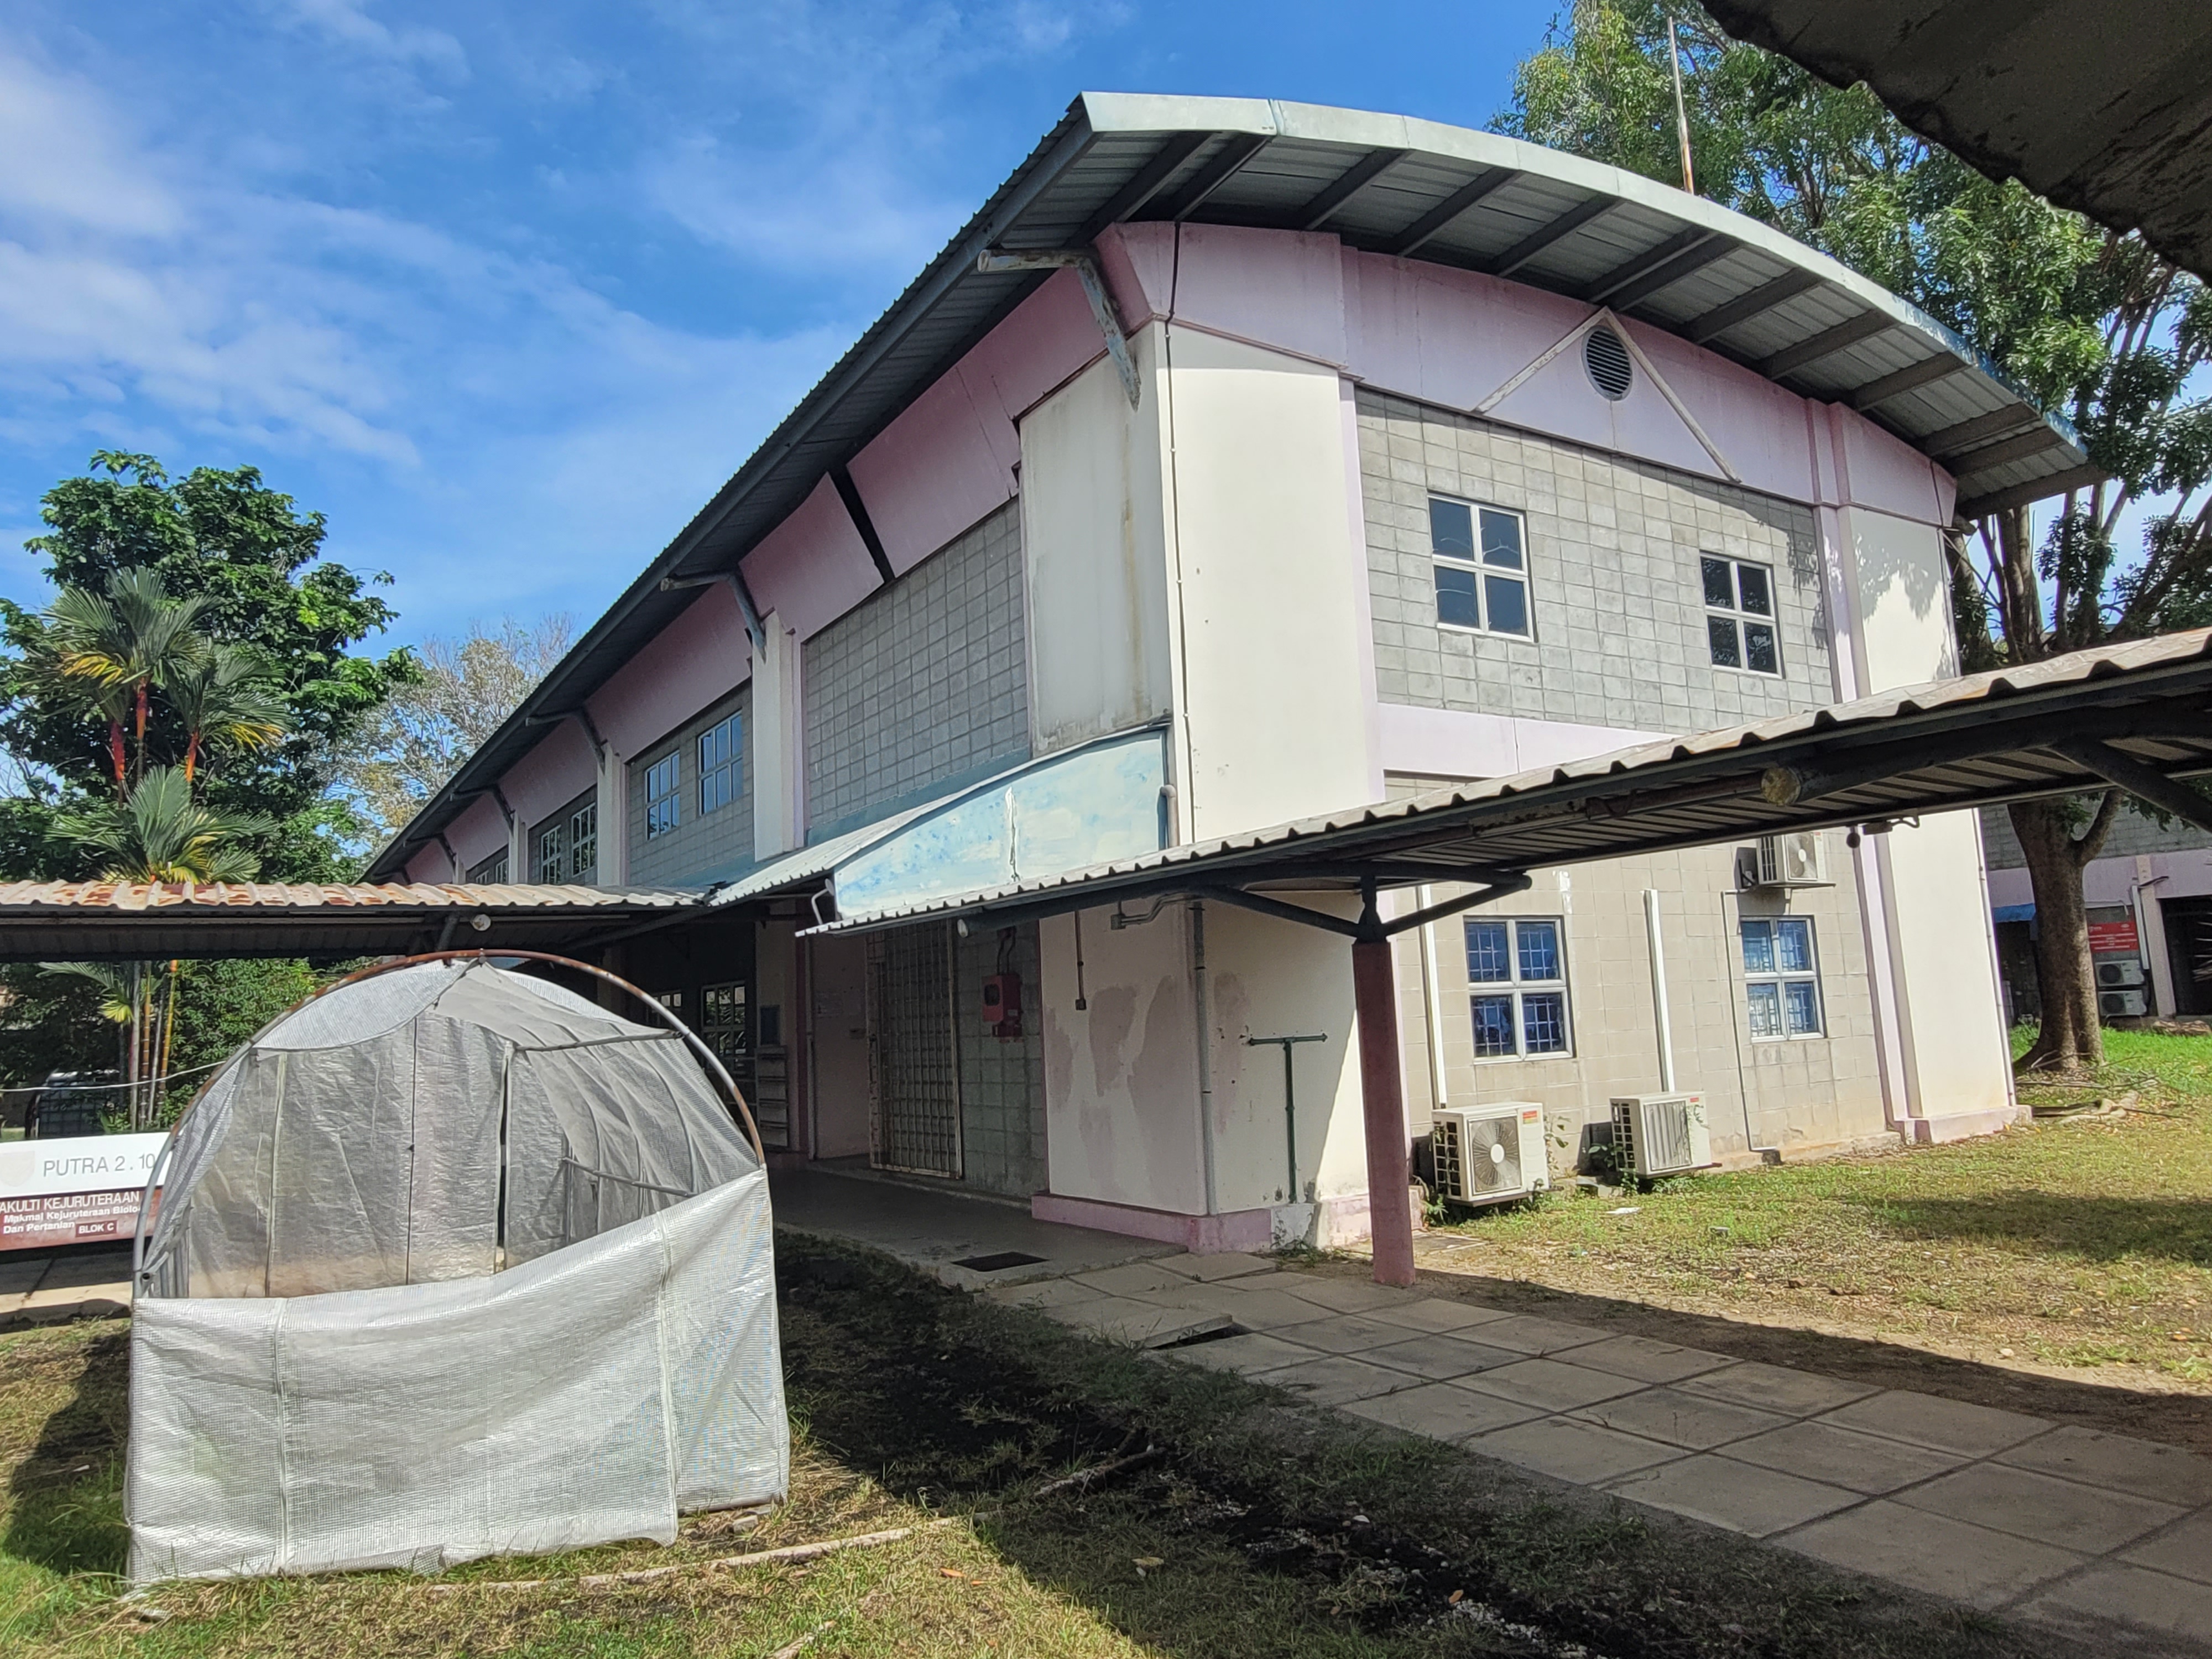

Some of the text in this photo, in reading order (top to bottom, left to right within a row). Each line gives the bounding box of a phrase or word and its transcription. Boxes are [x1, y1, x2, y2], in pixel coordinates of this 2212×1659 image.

[43, 1156, 109, 1177] PUTRA
[0, 1191, 140, 1213] AKULTI KEJURUTERAAN
[46, 1206, 110, 1221] Kejuruteraan
[112, 1204, 140, 1214] Biolo
[3, 1220, 75, 1234] Dan Pertanian
[78, 1222, 114, 1234] BLOK C
